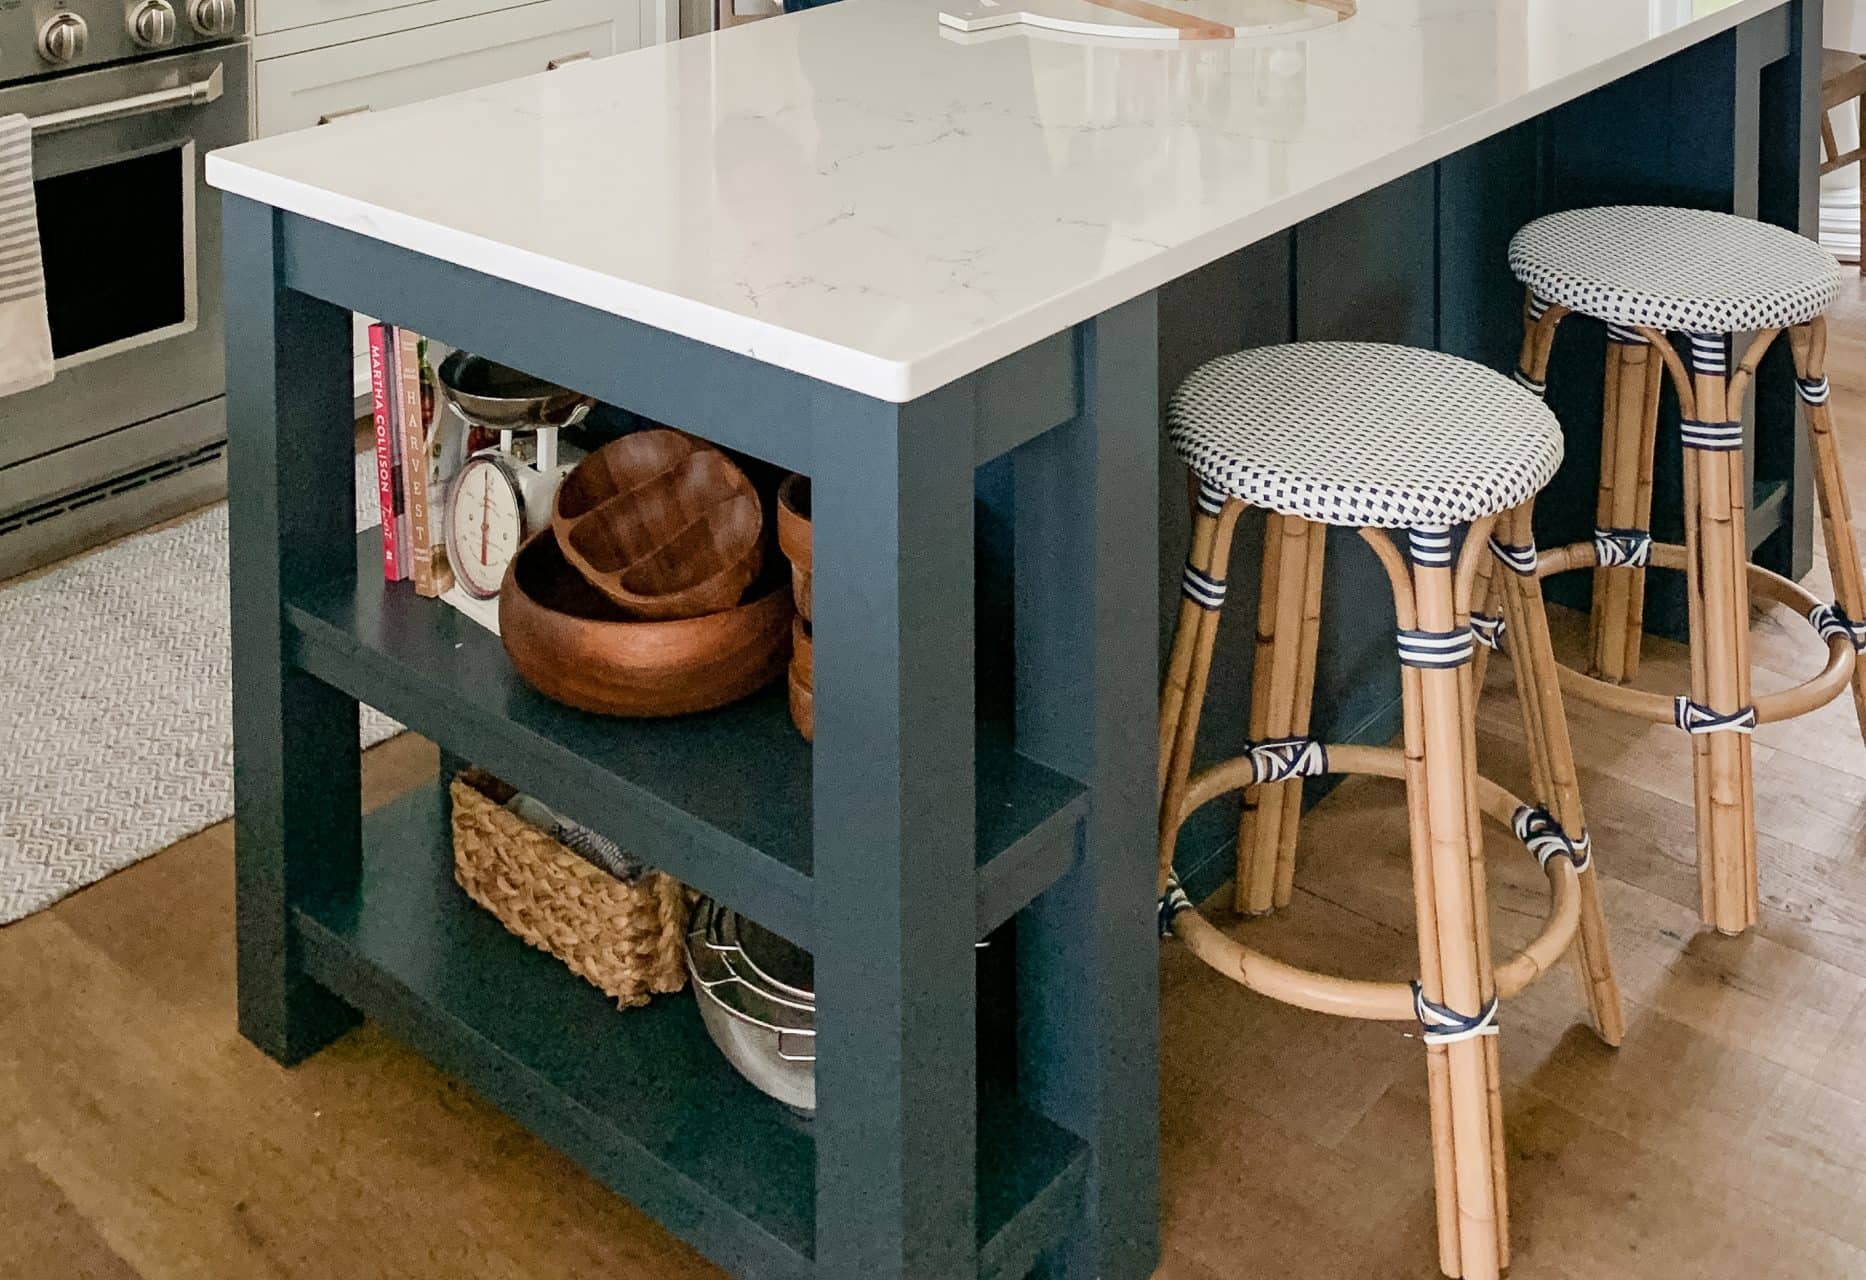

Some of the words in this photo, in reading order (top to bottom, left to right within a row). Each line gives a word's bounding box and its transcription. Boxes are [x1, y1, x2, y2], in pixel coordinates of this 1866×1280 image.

[371, 345, 384, 410] MARTHA
[376, 415, 390, 492] COLLISON
[407, 391, 425, 541] HARVEST
